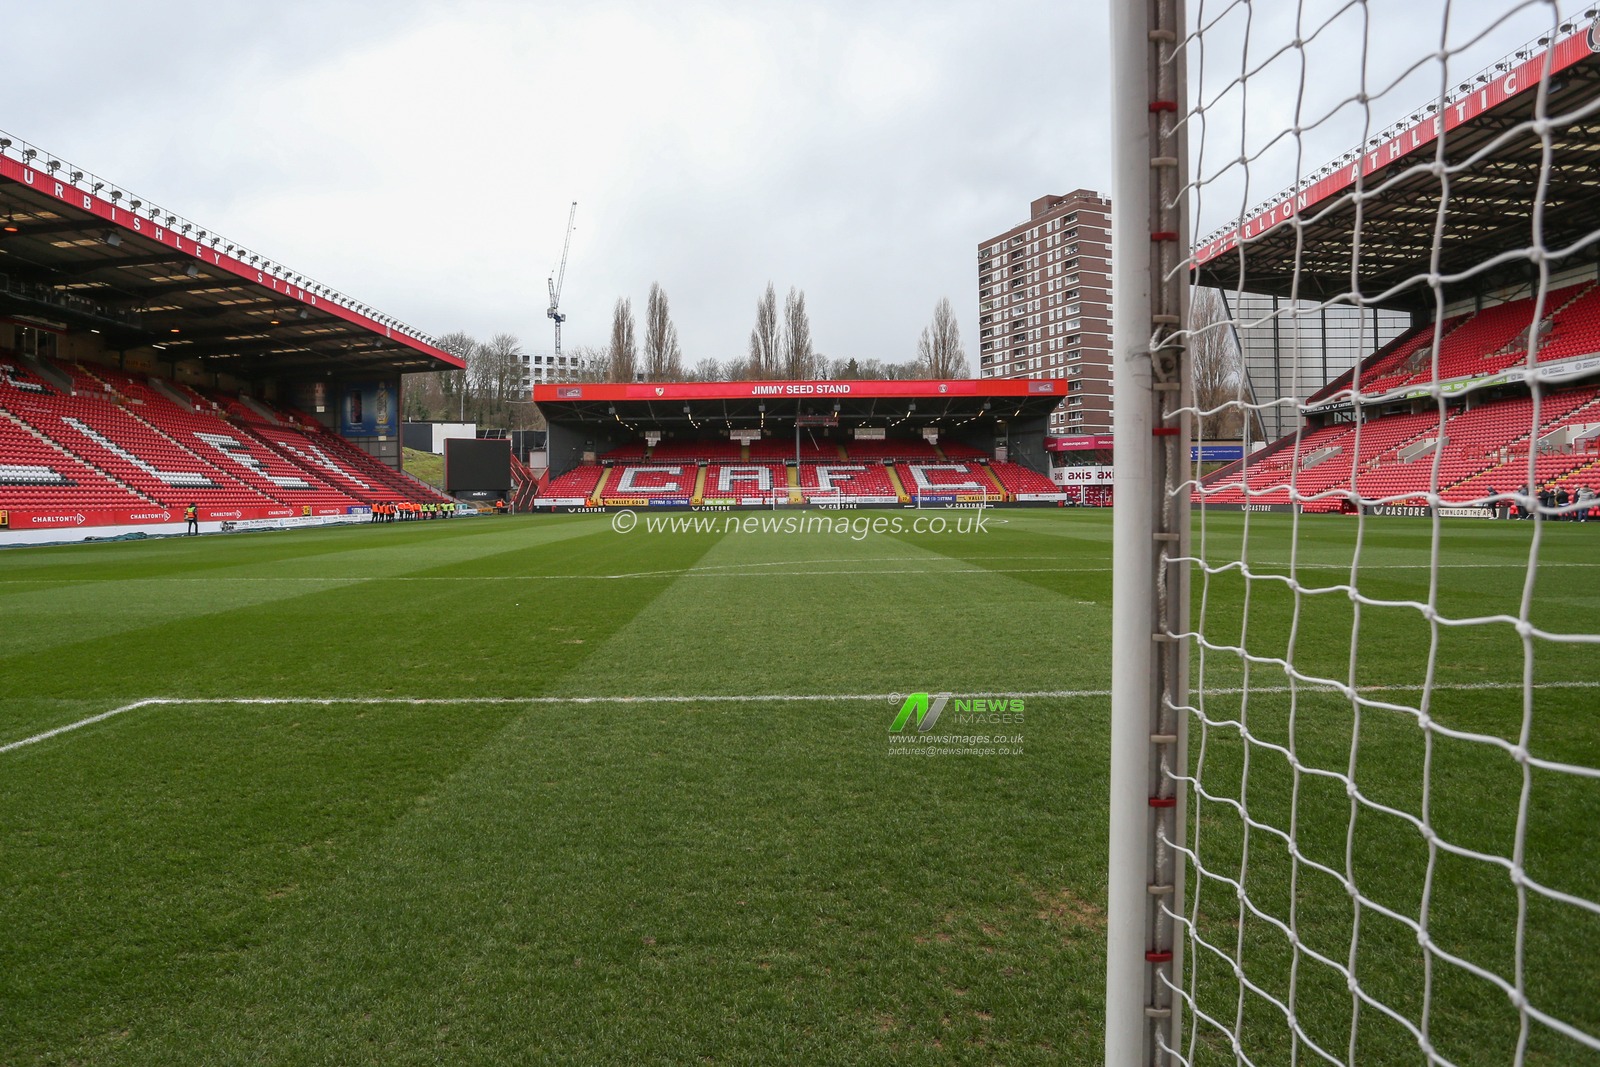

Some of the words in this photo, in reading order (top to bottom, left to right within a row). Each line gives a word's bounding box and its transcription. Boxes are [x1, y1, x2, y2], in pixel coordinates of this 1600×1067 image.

[1350, 72, 1517, 181] ATHLETIC
[0, 159, 220, 265] URBISHLEY
[257, 272, 316, 305] STAND
[751, 385, 784, 395] JIMMY
[786, 385, 814, 394] SEED
[816, 384, 850, 394] STAND
[1067, 469, 1092, 482] axis
[1385, 506, 1425, 517] CASTORE
